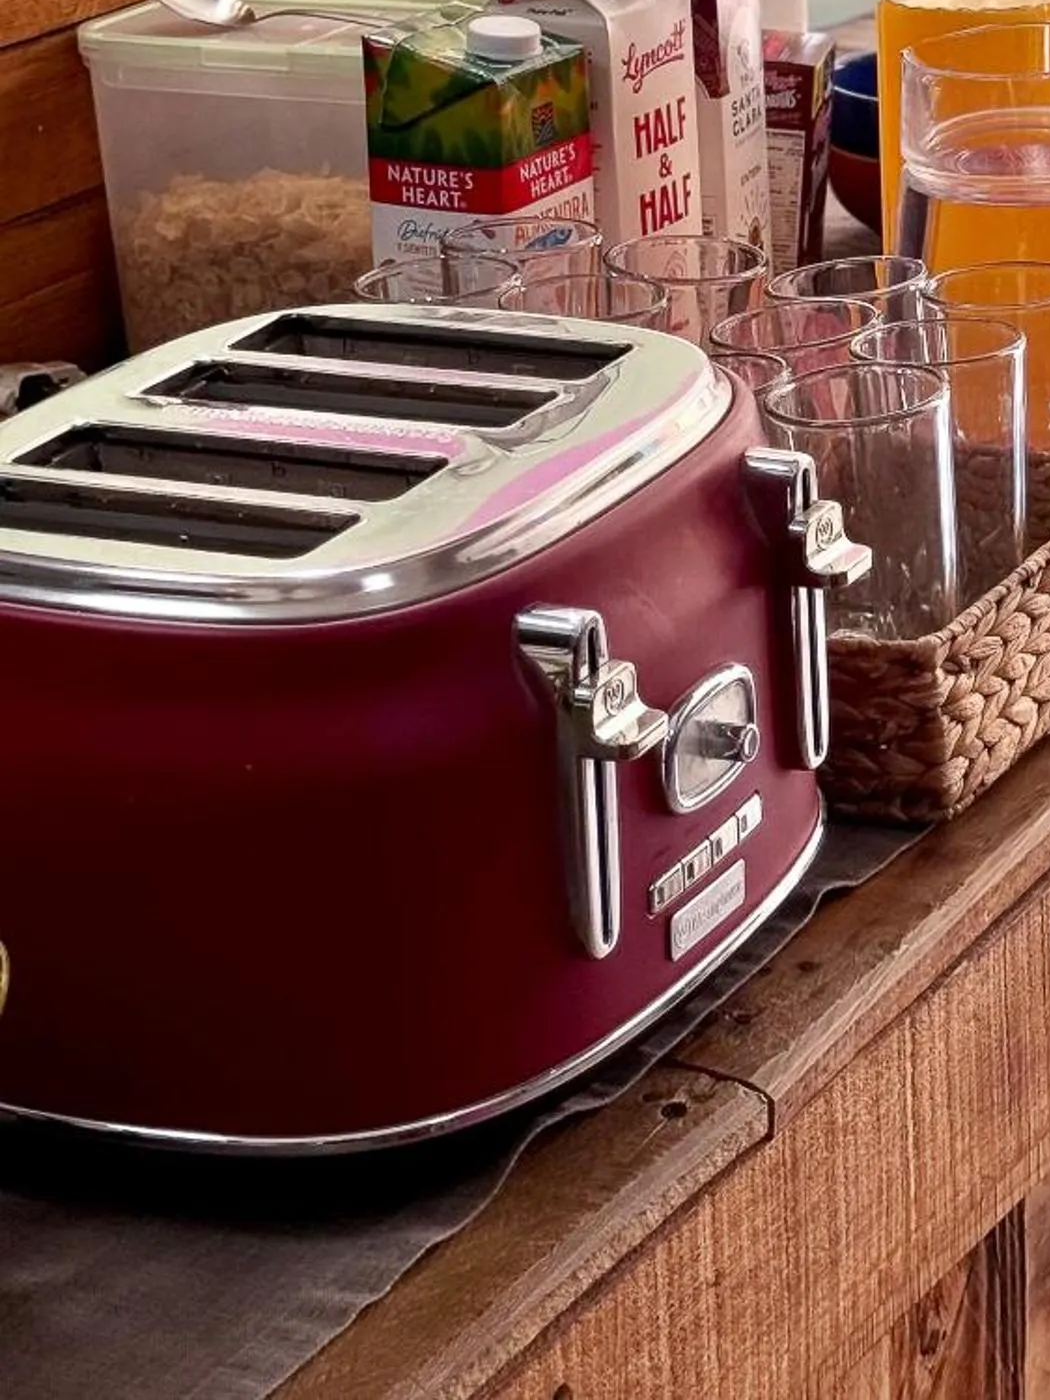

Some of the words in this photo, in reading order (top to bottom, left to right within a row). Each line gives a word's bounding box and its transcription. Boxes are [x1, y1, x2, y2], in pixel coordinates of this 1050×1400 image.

[634, 96, 686, 159] HALF
[387, 165, 474, 190] NATURE'S
[519, 143, 576, 183] NATURE'S
[658, 153, 673, 178] &
[402, 185, 461, 208] HEART
[531, 166, 569, 198] HEART
[639, 172, 691, 236] HALF
